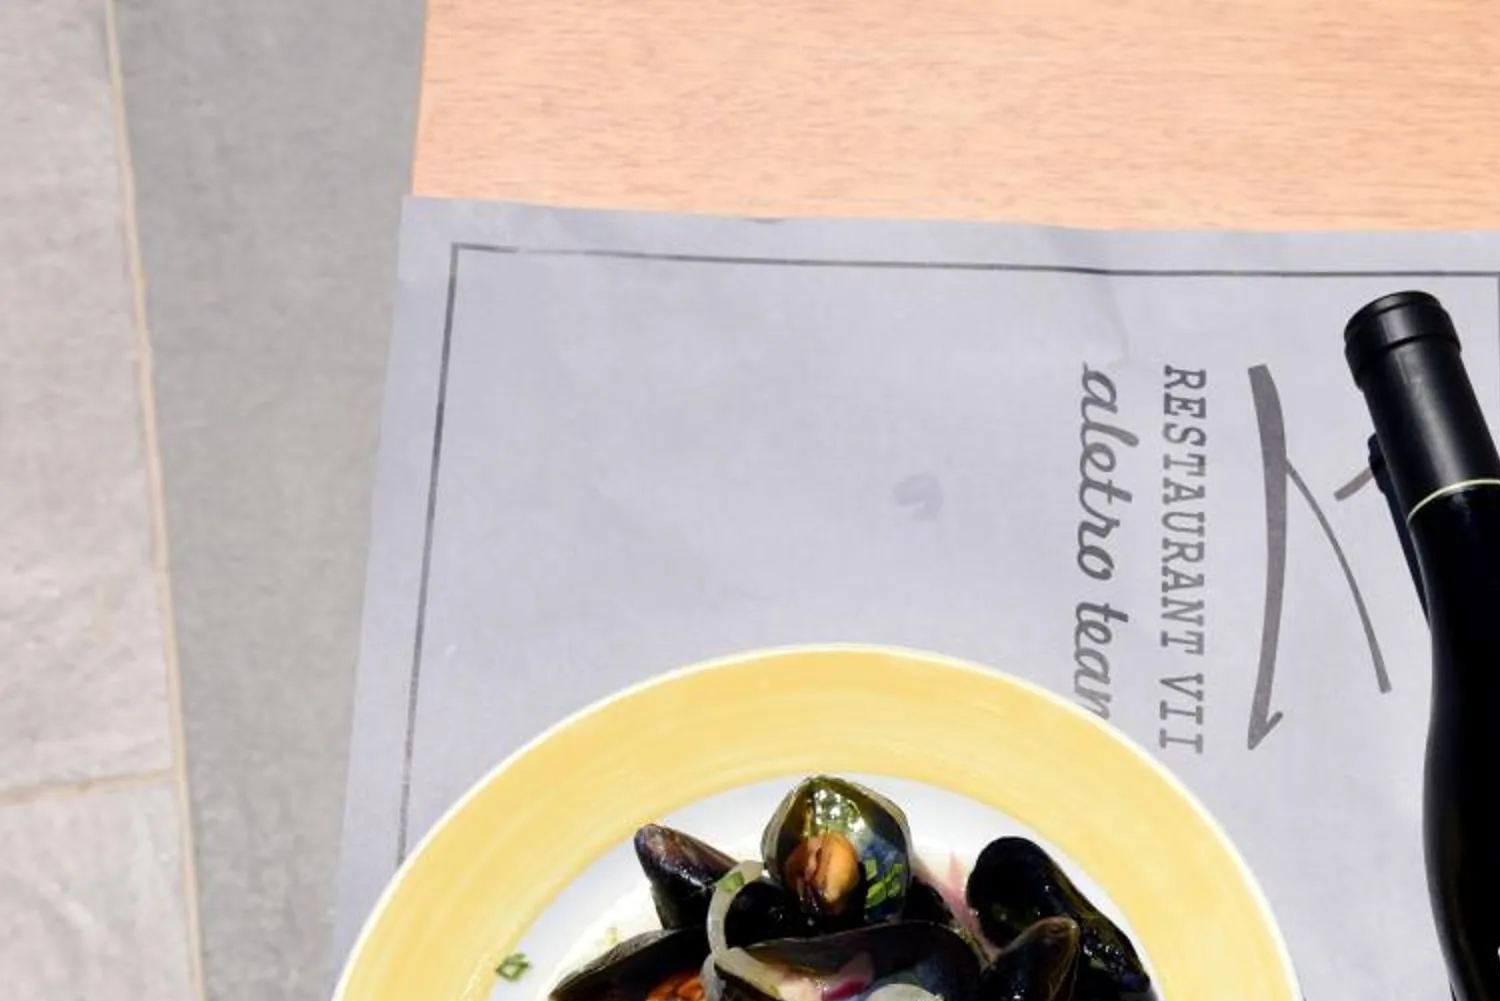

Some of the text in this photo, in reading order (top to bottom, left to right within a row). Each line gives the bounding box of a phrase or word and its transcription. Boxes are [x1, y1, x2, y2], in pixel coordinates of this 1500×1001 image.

[1076, 362, 1140, 580] aletro
[1158, 364, 1207, 754] RESTAURANT VII
